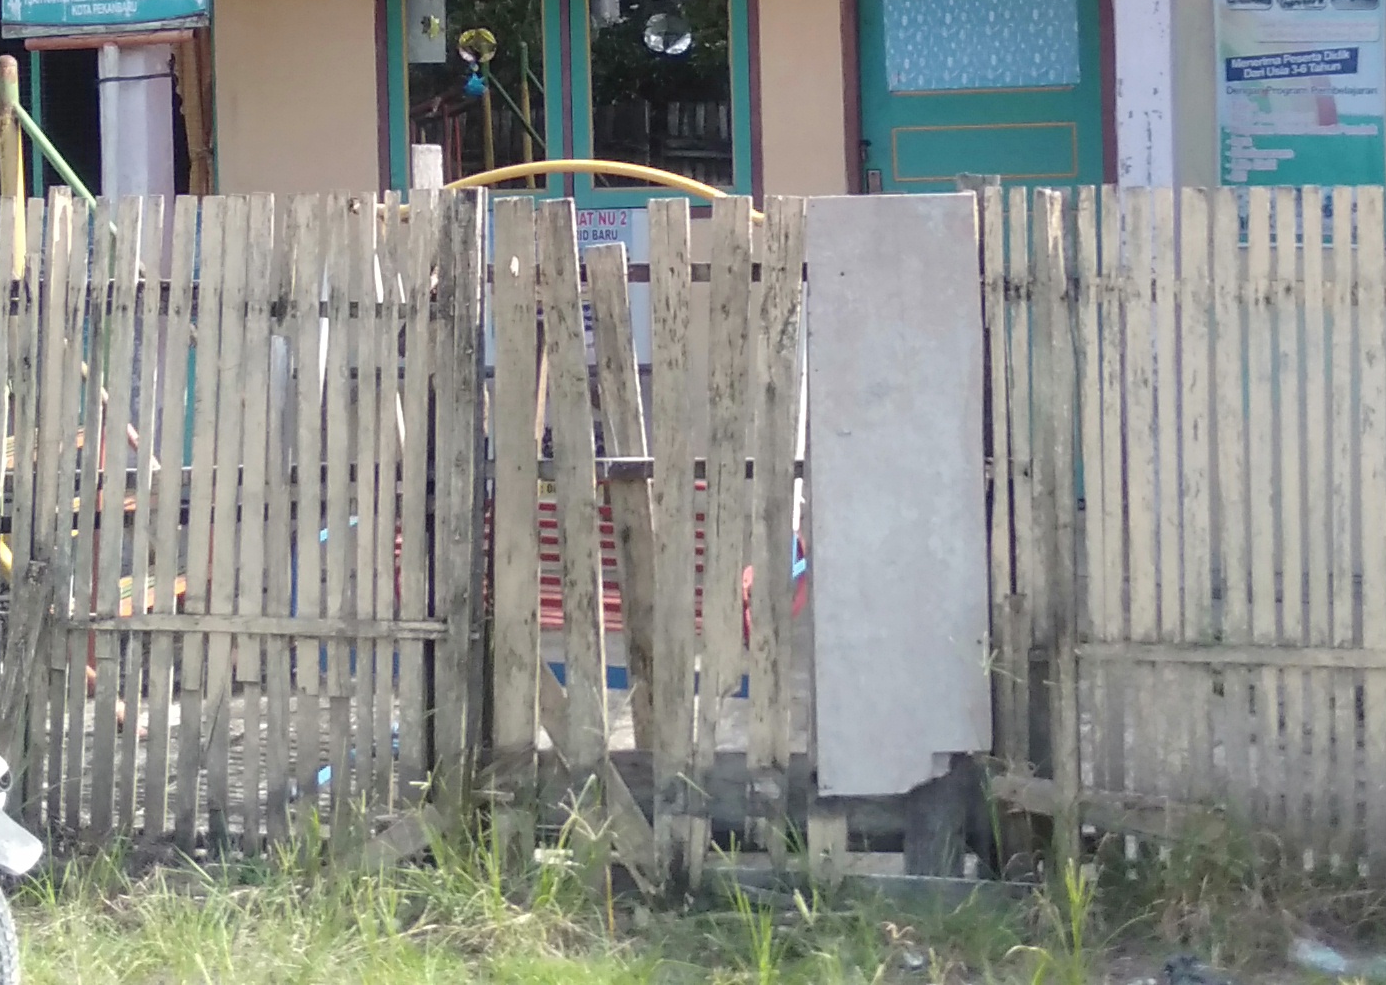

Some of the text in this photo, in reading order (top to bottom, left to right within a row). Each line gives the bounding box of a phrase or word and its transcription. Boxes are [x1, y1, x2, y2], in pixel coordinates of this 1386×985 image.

[71, 5, 90, 16] KOTA
[1323, 50, 1350, 61] Didik
[1266, 66, 1290, 77] Usia
[1291, 64, 1307, 75] 3-6
[1308, 62, 1342, 72] Tahun
[1266, 86, 1306, 97] Program
[598, 211, 616, 226] NU
[620, 211, 627, 225] 2
[592, 229, 618, 241] BARU
